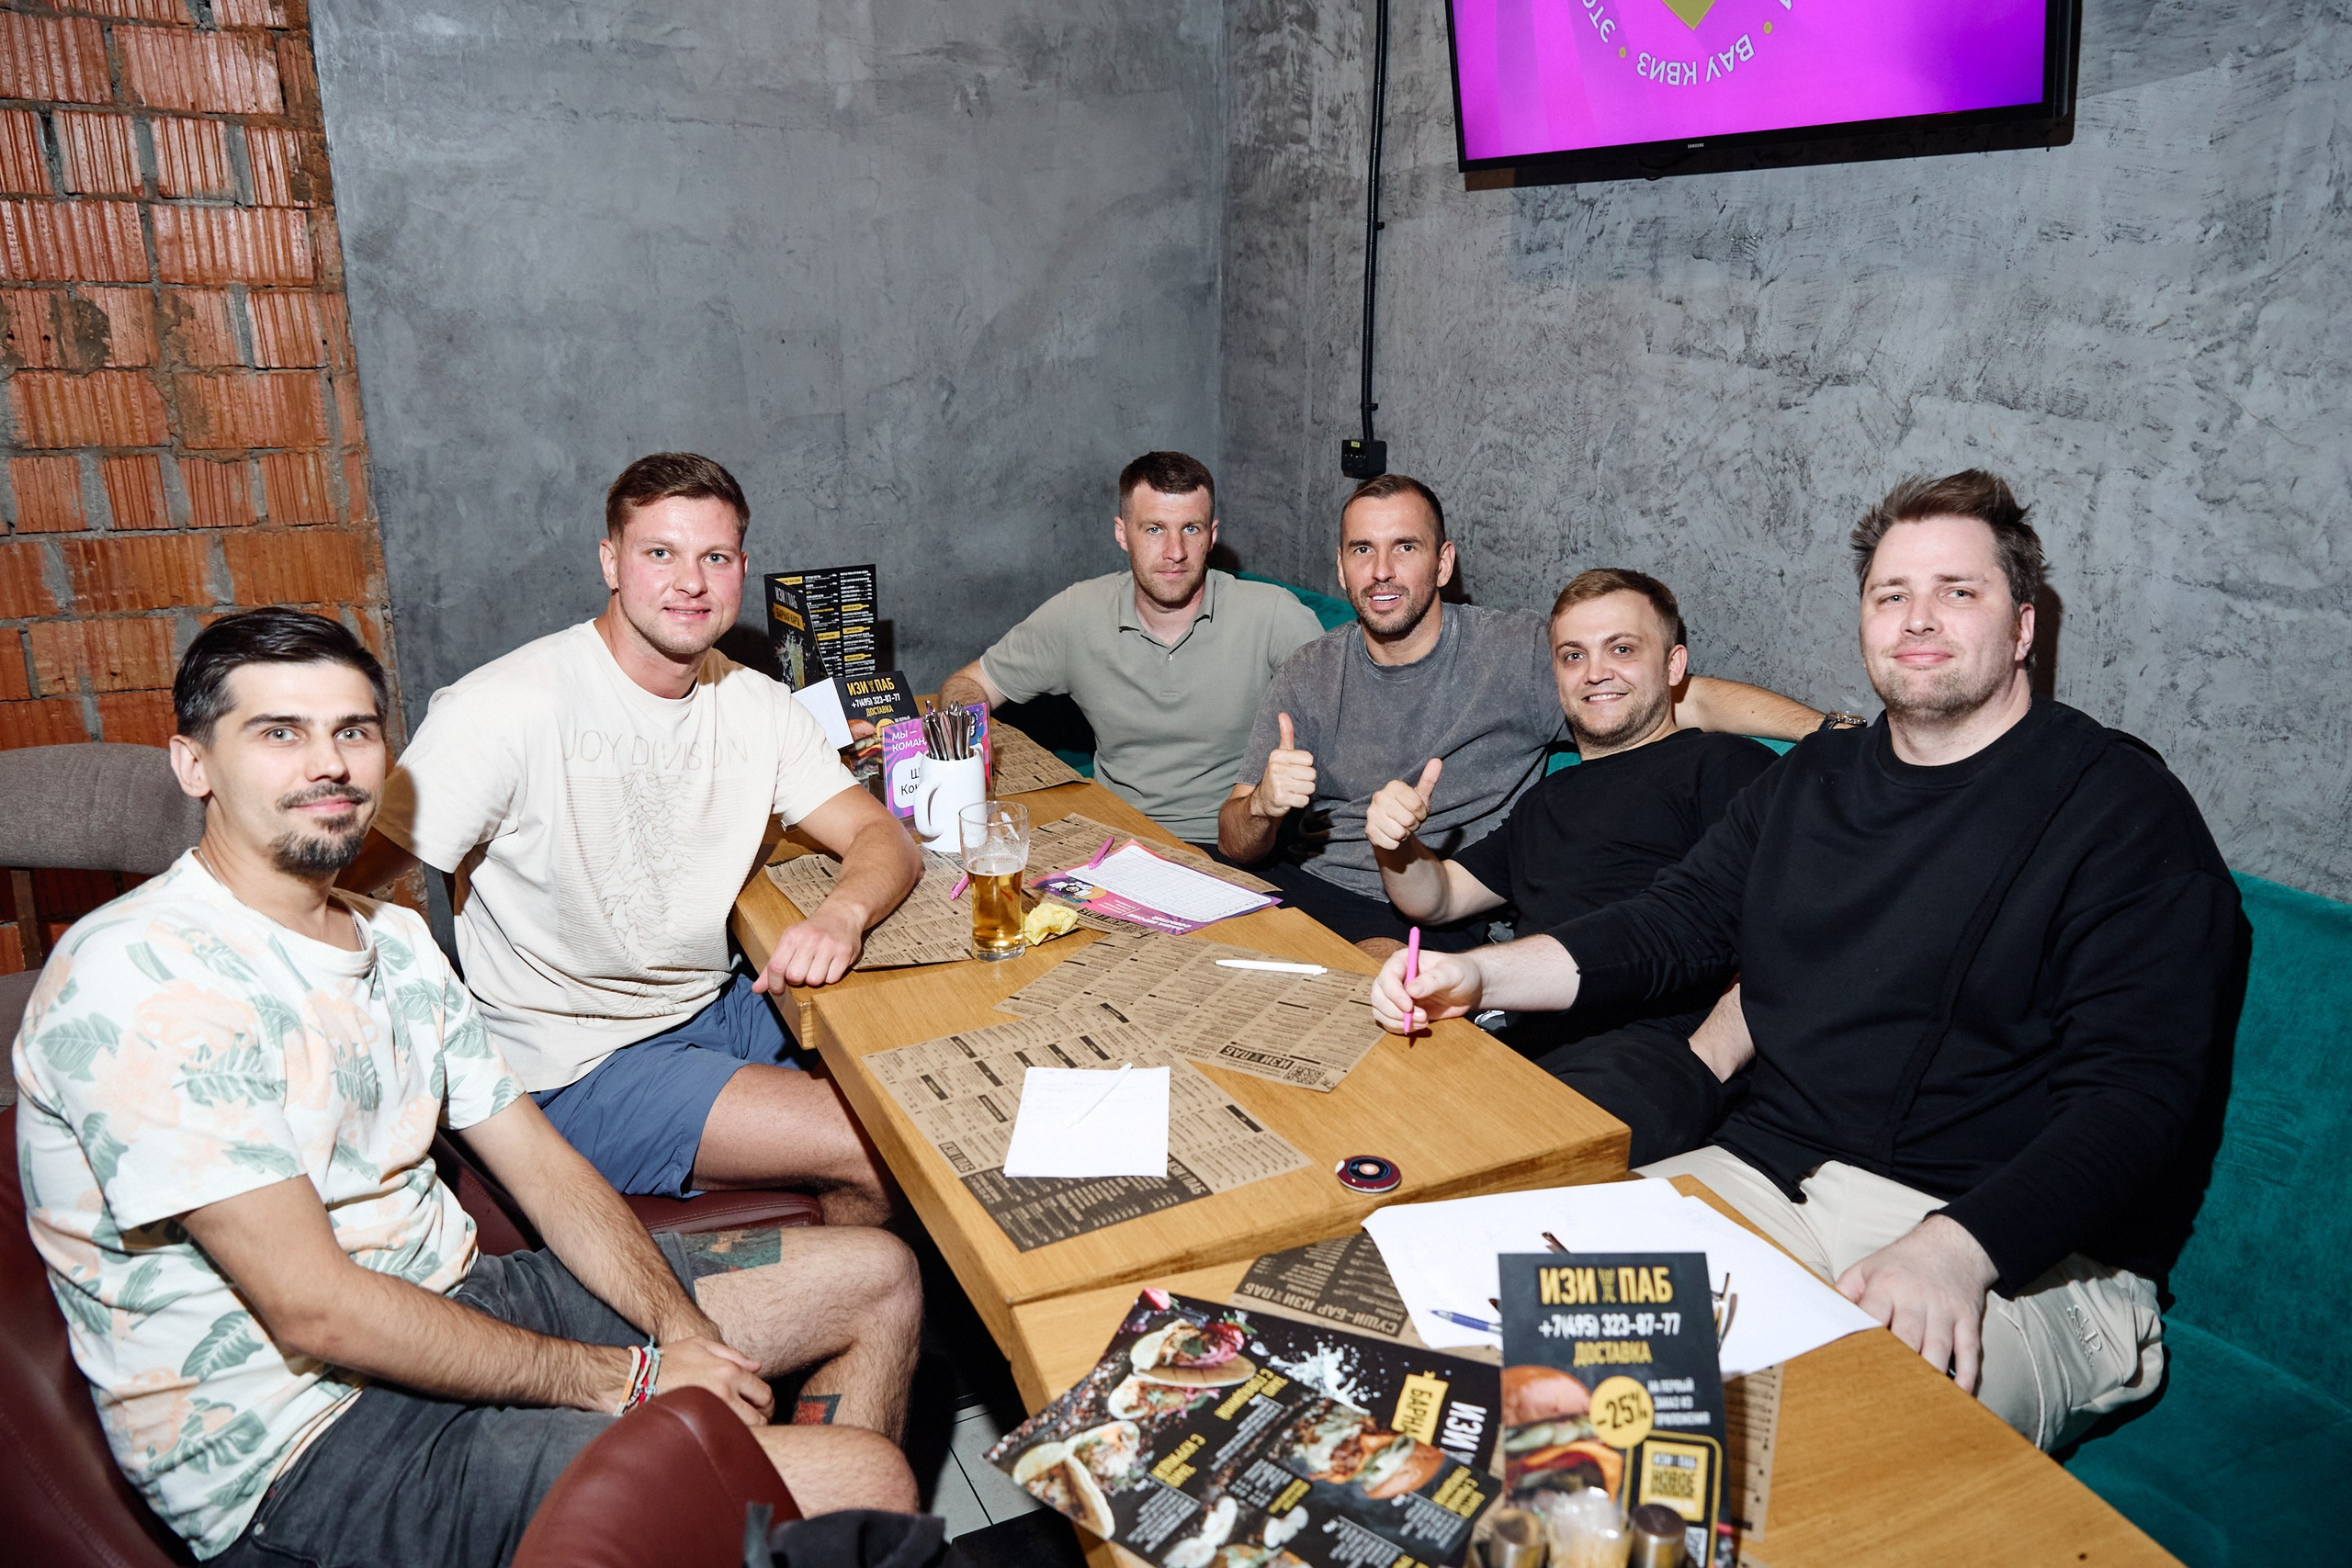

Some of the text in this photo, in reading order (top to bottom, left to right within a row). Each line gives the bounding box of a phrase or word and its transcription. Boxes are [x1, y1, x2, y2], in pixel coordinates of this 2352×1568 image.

[1636, 34, 1755, 85] ВАУ КВИЗ
[846, 677, 896, 696] ИЗИ ПАБ
[865, 705, 894, 717] ДОСТАВКА
[892, 730, 909, 741] МЫ
[563, 729, 750, 772] JOY DIVISION
[1222, 1046, 1252, 1061] ПАБ
[1259, 1055, 1293, 1069] ИЗИ
[1182, 1177, 1206, 1194] ПАБ
[1539, 1266, 1674, 1305] ИЗИ ПАБ
[1244, 1282, 1398, 1336] СУШИ-БАР ИЗИ ПАБ
[1538, 1312, 1681, 1340] +7(495) 323-87-77
[1573, 1340, 1653, 1367] ДОСТАВКА
[1402, 1387, 1433, 1438] БАРНА
[1595, 1391, 1648, 1430] -25%
[1440, 1400, 1488, 1451] ИЗИ
